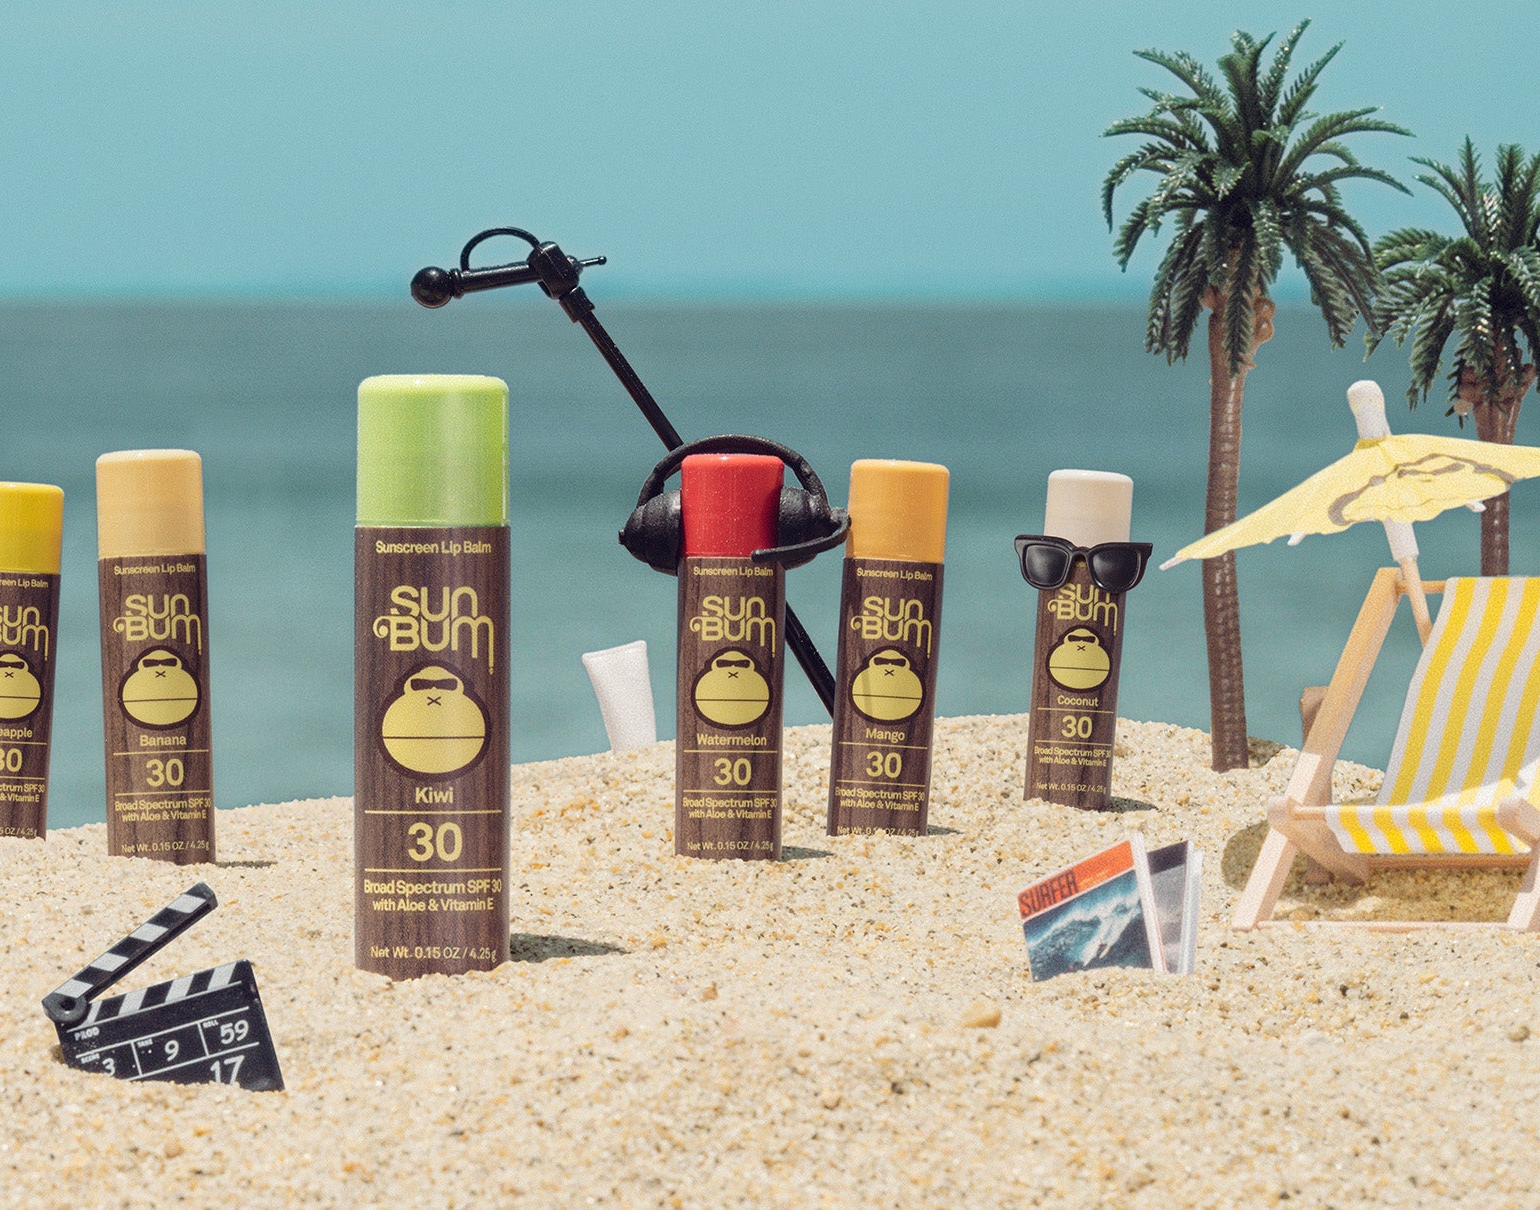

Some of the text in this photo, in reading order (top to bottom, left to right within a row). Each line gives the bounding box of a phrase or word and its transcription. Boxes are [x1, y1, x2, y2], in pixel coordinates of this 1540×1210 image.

[375, 540, 491, 556] Sunscreen Lip Balm
[114, 563, 196, 575] Sunscreen Lip Balm
[693, 566, 773, 577] Sunscreen Lip Balm
[856, 567, 933, 581] Sunscreen Lip Balm
[18, 579, 29, 588] Lip
[31, 579, 48, 588] Balm
[1057, 695, 1099, 707] Coconut
[1061, 715, 1092, 738] 30
[140, 734, 186, 747] Banana
[696, 733, 766, 746] Watermelon
[865, 727, 905, 743] Mango
[1034, 745, 1111, 758] Broad Spectrum SPF 30
[865, 751, 902, 778] 30
[1054, 756, 1070, 765] Aloe
[1071, 757, 1077, 765] &
[1078, 757, 1103, 766] Vitamin
[146, 758, 184, 787] 30
[714, 758, 751, 785] 30
[24, 784, 38, 792] SPF
[38, 785, 44, 793] 30
[835, 787, 925, 801] Broad Spectrum SPF 30
[0, 793, 6, 801] &
[7, 793, 35, 802] Vitamin
[415, 787, 454, 804] Kiwi
[115, 798, 210, 813] Broad Spectrum SPF 30
[683, 797, 777, 810] Broad Spectrum SPF 30
[840, 799, 856, 807] with
[856, 799, 875, 809] Aloe
[877, 801, 884, 809] &
[885, 801, 914, 811] Vitamin
[122, 812, 139, 822] with
[140, 810, 160, 821] Aloe
[162, 810, 169, 820] &
[170, 809, 201, 820] Vitamin
[688, 810, 705, 818] with
[706, 810, 726, 819] Aloe
[727, 810, 734, 819] &
[735, 810, 767, 819] Vitamin
[837, 826, 849, 835] Net
[122, 844, 135, 853] Net
[152, 842, 170, 851] 0.15
[172, 841, 184, 850] OZ
[408, 821, 462, 862] 30
[687, 842, 700, 850] Net
[717, 842, 735, 850] 0.15
[737, 841, 749, 850] OZ
[364, 879, 502, 897] Broad Spectrum SPF 30
[1019, 869, 1079, 917] SURFER
[373, 898, 395, 911] with
[397, 899, 426, 911] Aloe
[428, 899, 438, 911] &
[440, 899, 486, 911] Vitamin
[370, 946, 389, 958] Net
[391, 946, 412, 959] Wt.
[414, 947, 441, 959] 0.15
[443, 947, 460, 959] OZ
[74, 1027, 100, 1041] PROD
[220, 1020, 249, 1044] 59
[165, 1040, 179, 1061] 9
[102, 1057, 115, 1076] 3
[210, 1055, 245, 1085] 17
